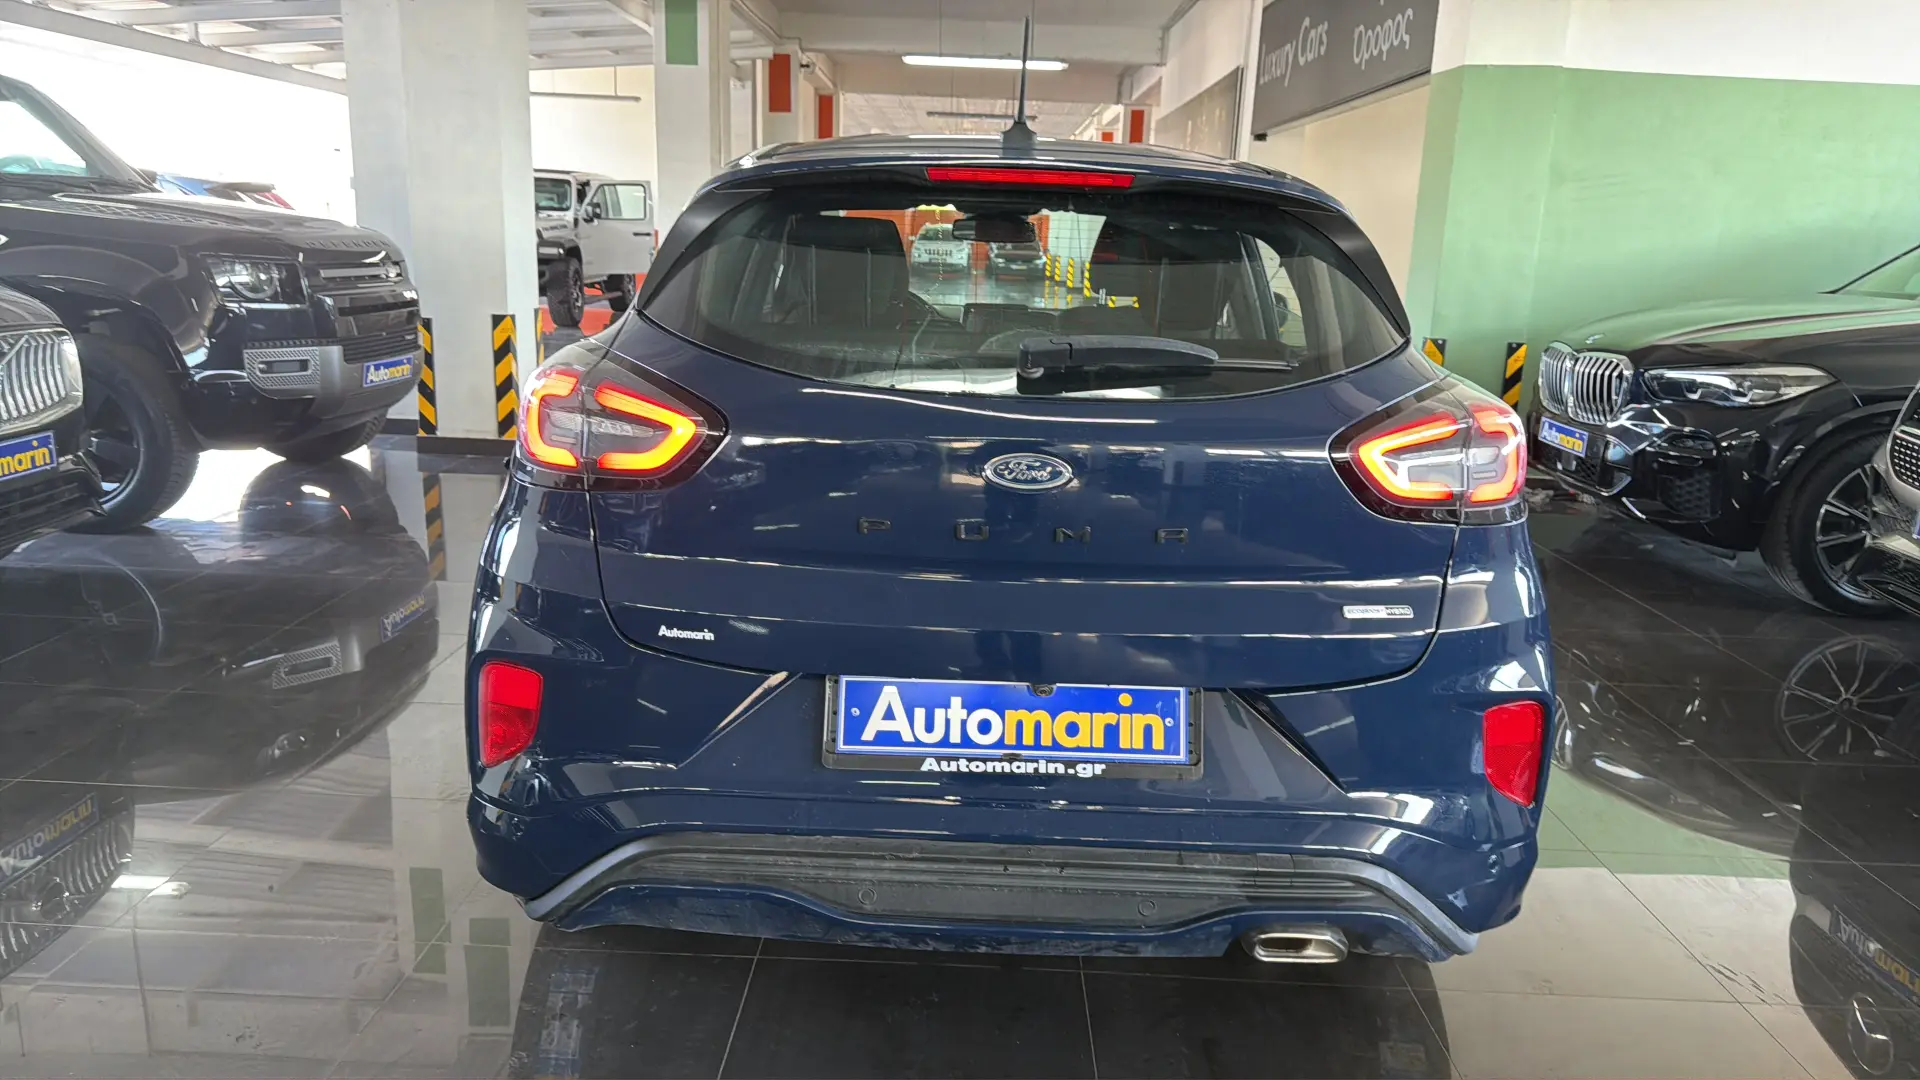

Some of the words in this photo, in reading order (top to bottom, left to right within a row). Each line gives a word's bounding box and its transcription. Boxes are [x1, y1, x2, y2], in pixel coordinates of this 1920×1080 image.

[1259, 40, 1297, 88] Luxury
[1298, 16, 1329, 66] Cars
[367, 359, 412, 383] Automarin
[996, 459, 1053, 481] Ford
[858, 516, 1190, 545] PUMA
[658, 625, 715, 641] Automarin
[860, 685, 1165, 751] Automarin
[920, 757, 1107, 778] Automarin.gr
